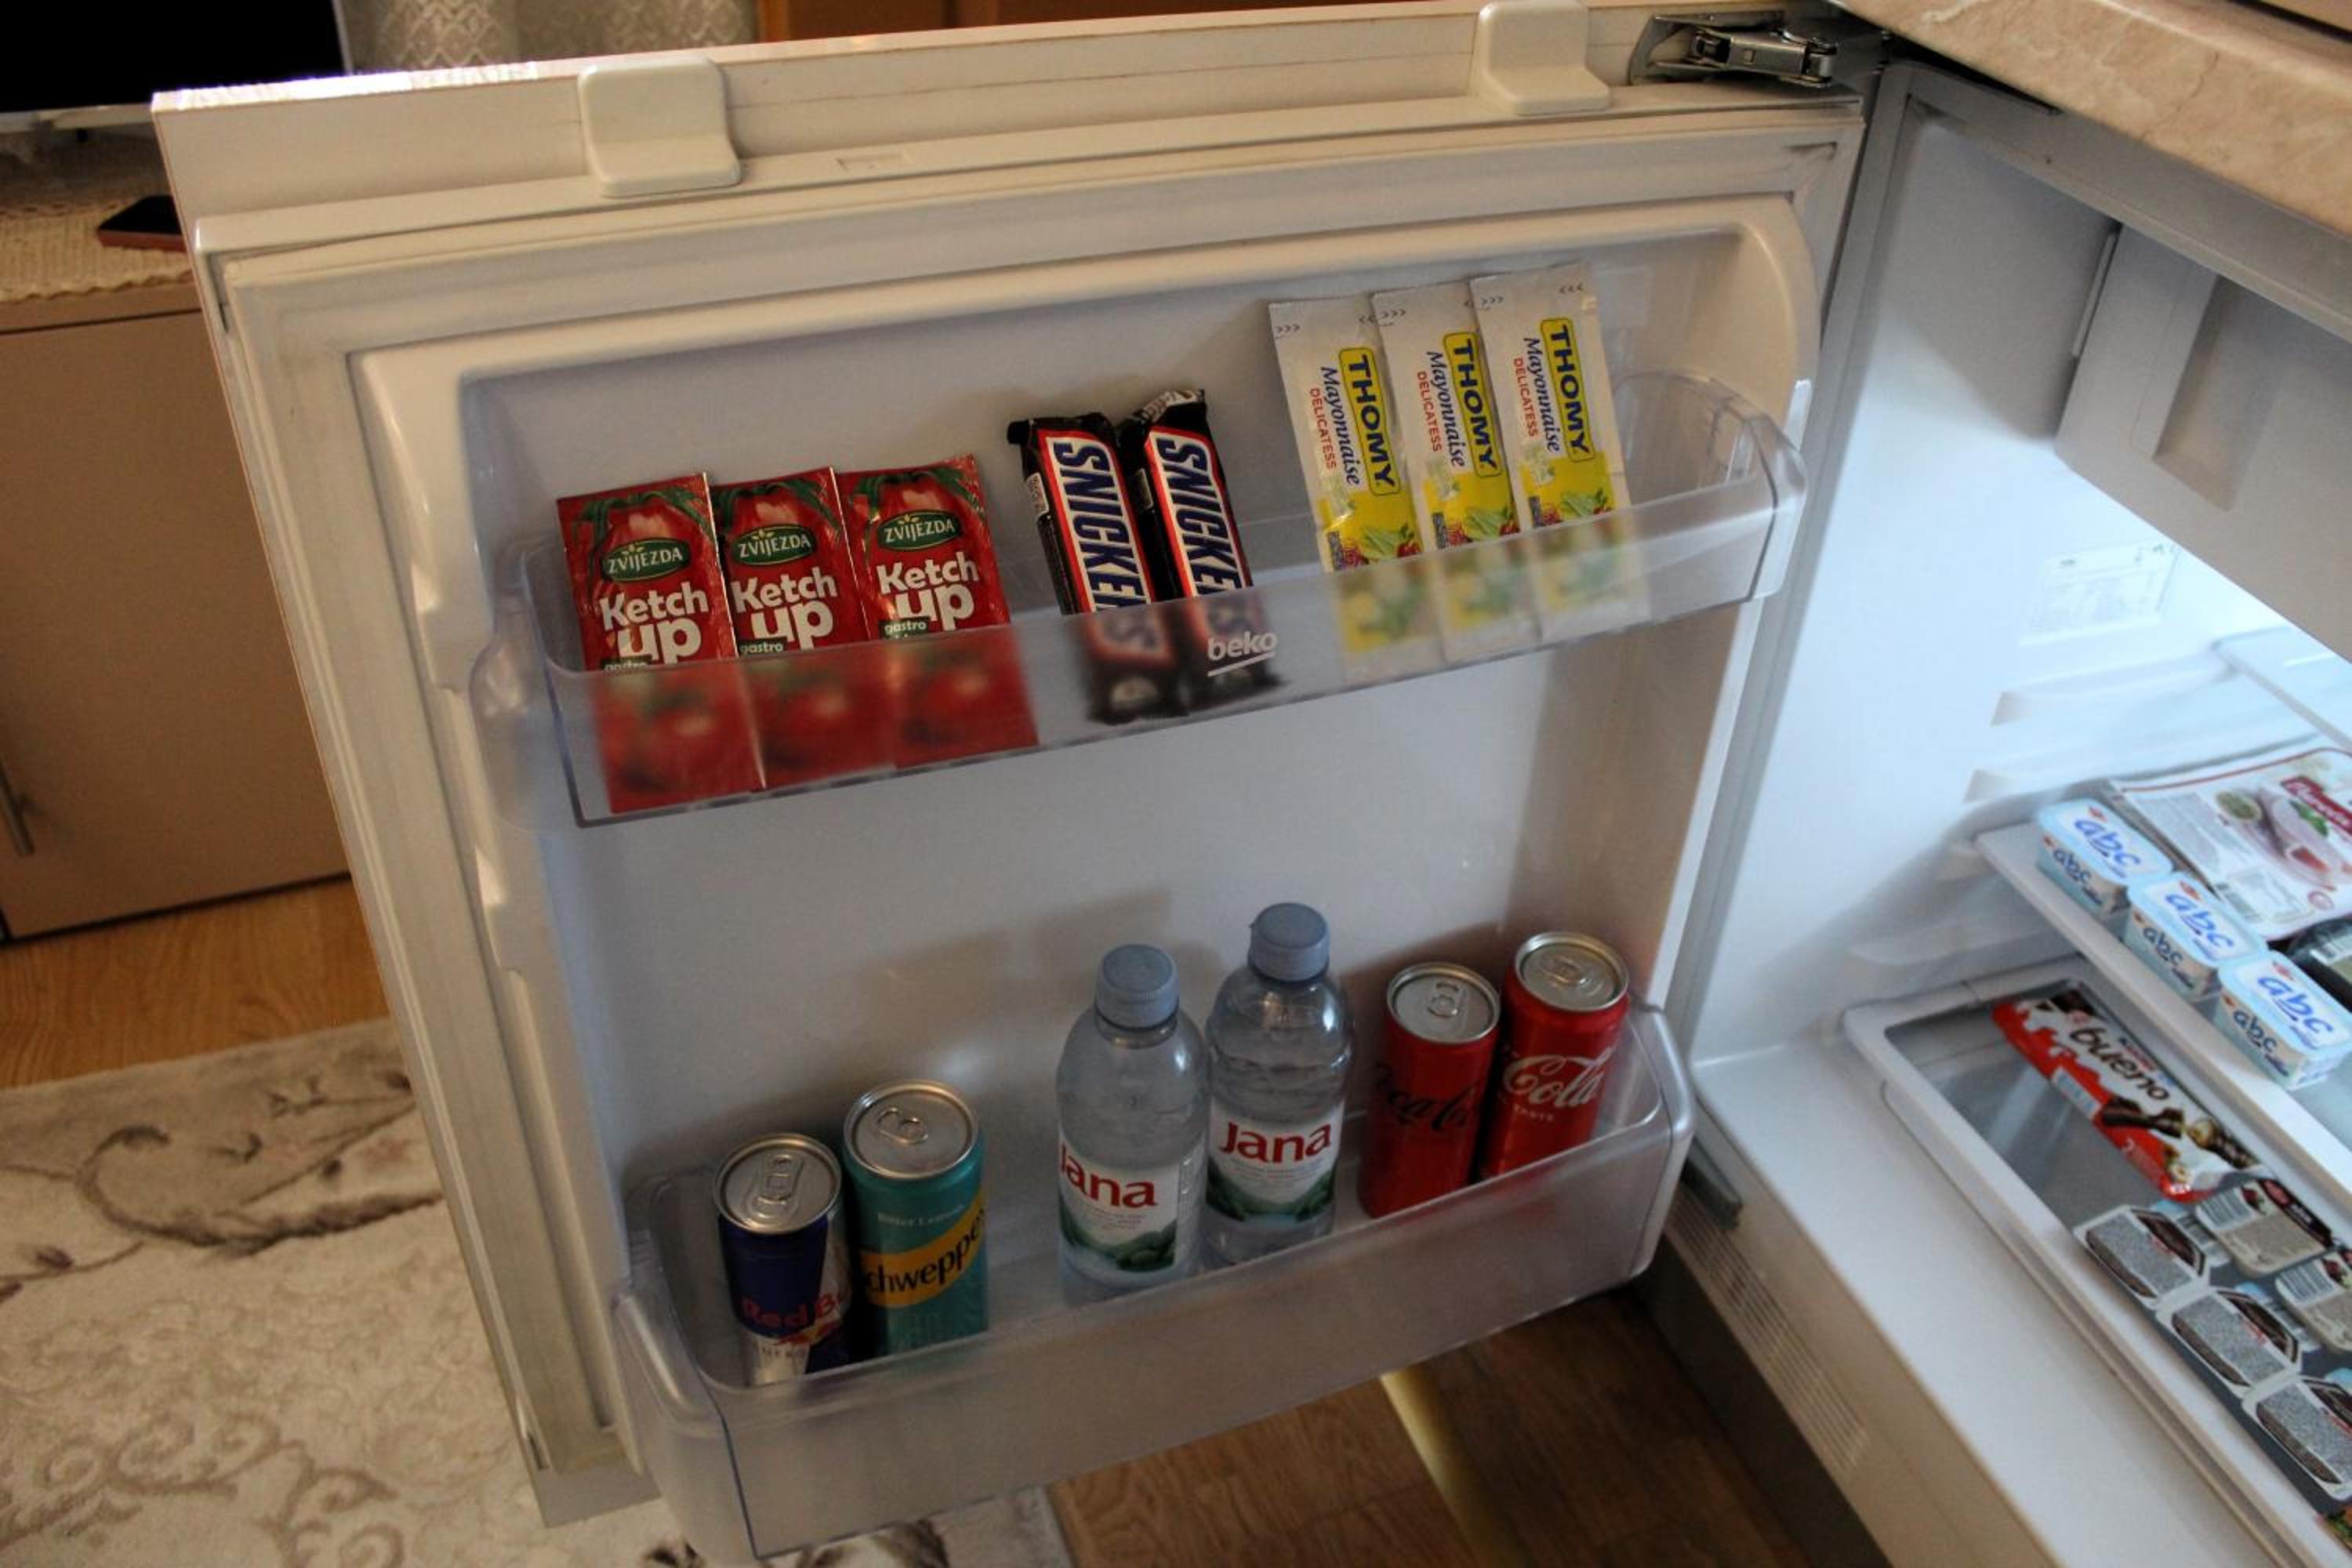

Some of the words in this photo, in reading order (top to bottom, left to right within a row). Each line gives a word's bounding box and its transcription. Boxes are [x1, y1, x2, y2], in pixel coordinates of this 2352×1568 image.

[1417, 371, 1442, 452] DELICATESS
[1427, 350, 1465, 467] Mayonnaise
[1454, 339, 1495, 470] THOMY
[1514, 357, 1538, 437] DELICATESS
[1523, 336, 1560, 452] Mayonnaise
[1551, 325, 1589, 453] THOMY
[1310, 388, 1337, 470] DELICATESS
[1320, 366, 1361, 485] Mayonnaise
[1348, 354, 1394, 488] THOMY
[883, 517, 955, 543] ZVIJEZDA
[1053, 442, 1145, 608] SNICKE
[1156, 437, 1243, 590] SNICKE
[607, 546, 684, 574] ZVIJEZDA
[738, 533, 811, 560] ZVIJEZDA
[731, 568, 837, 614] Ketch
[876, 552, 979, 595] Ketch
[599, 582, 709, 630] Ketch
[750, 600, 833, 650] up
[884, 619, 927, 634] gastro
[895, 582, 975, 630] up
[617, 616, 702, 664] up
[739, 641, 783, 656] gastro
[1207, 630, 1277, 661] beko
[2053, 848, 2091, 880] abc
[2074, 819, 2140, 866] abc
[2165, 893, 2233, 947] abc
[2143, 927, 2183, 965] abc
[2258, 977, 2332, 1034] abc
[2234, 1010, 2277, 1053] abc
[2069, 1028, 2170, 1100] bueno
[1219, 1121, 1330, 1163] Jana
[862, 1211, 982, 1292] chweppe
